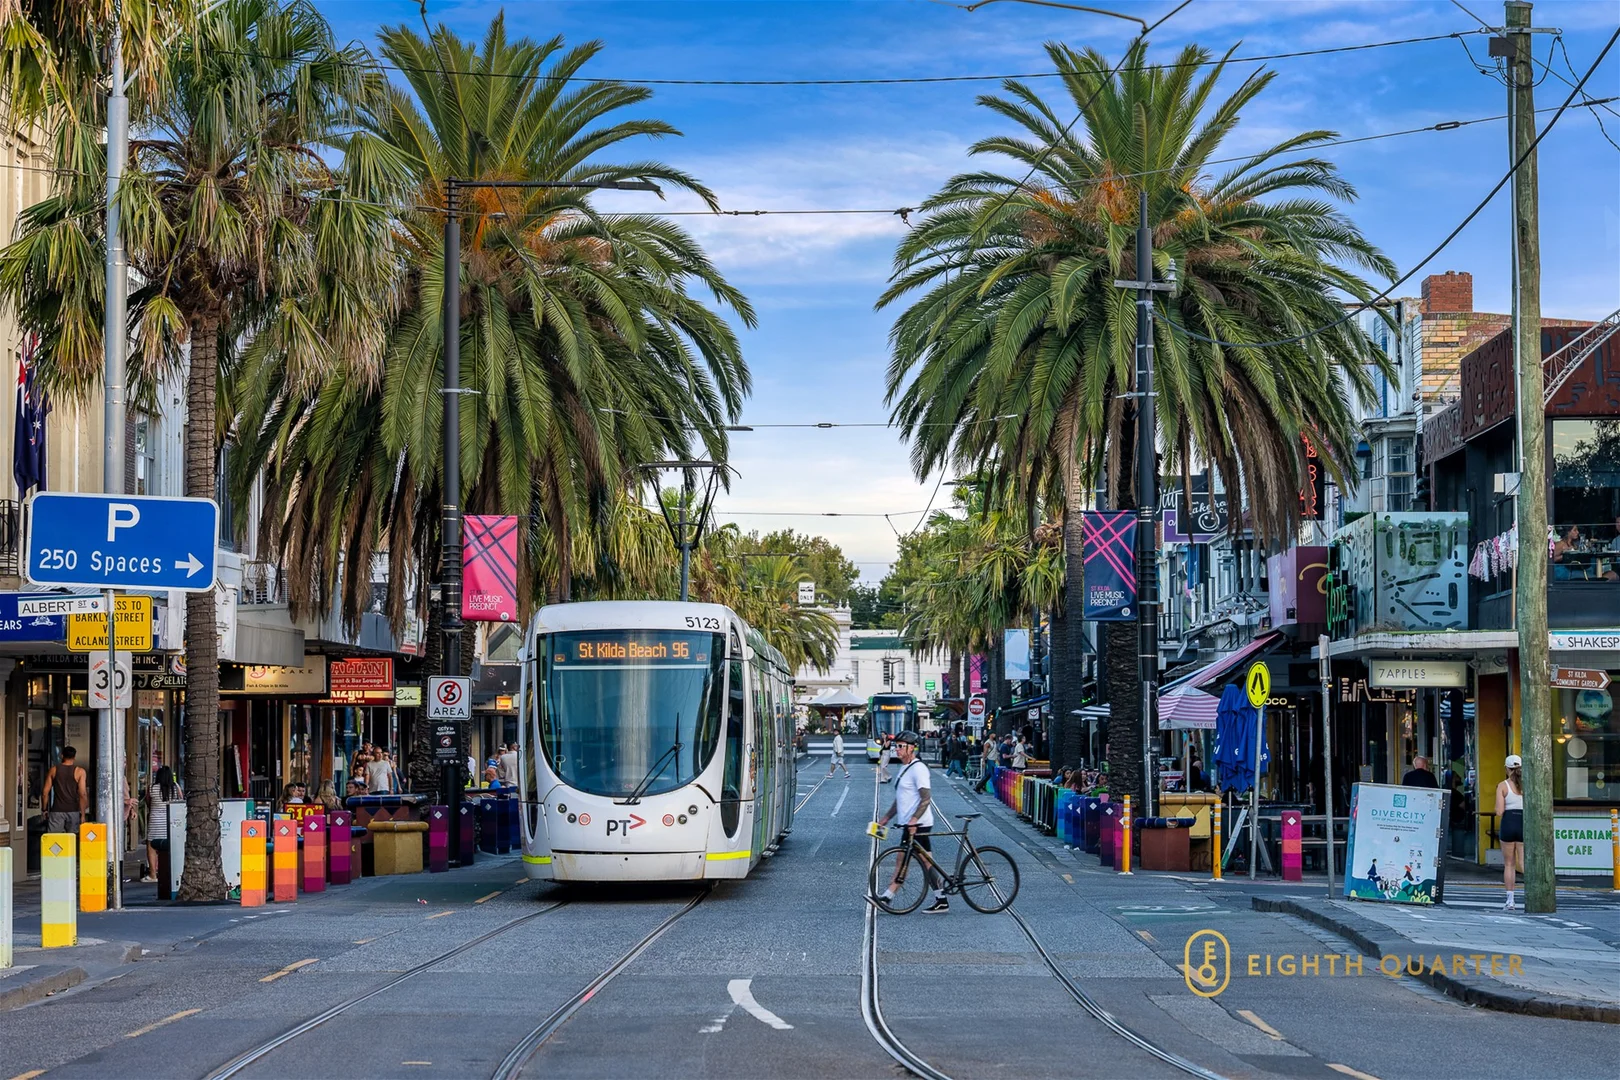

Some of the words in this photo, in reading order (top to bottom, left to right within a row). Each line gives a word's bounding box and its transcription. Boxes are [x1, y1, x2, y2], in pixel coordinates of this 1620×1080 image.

[107, 502, 140, 542] P
[39, 548, 78, 570] 250
[90, 550, 162, 576] Spaces
[484, 595, 503, 604] MUSIC
[22, 600, 74, 614] ALBERT
[132, 601, 141, 610] TO
[469, 602, 498, 611] PRECINCT
[76, 613, 108, 622] BARKLY
[685, 616, 720, 629] 5123
[76, 636, 109, 646] ACLAND
[1568, 637, 1620, 648] SHAKESP
[579, 642, 593, 658] St
[597, 642, 626, 658] Kilda
[628, 642, 667, 658] Beach
[672, 642, 689, 658] 96
[143, 656, 158, 664] INC.
[331, 662, 383, 675] ALIAN
[96, 669, 125, 690] 30
[151, 674, 164, 688] &
[1371, 809, 1426, 820] DIVERCITY
[1554, 830, 1612, 840] EGETARIAN
[1567, 845, 1592, 855] CAFE
